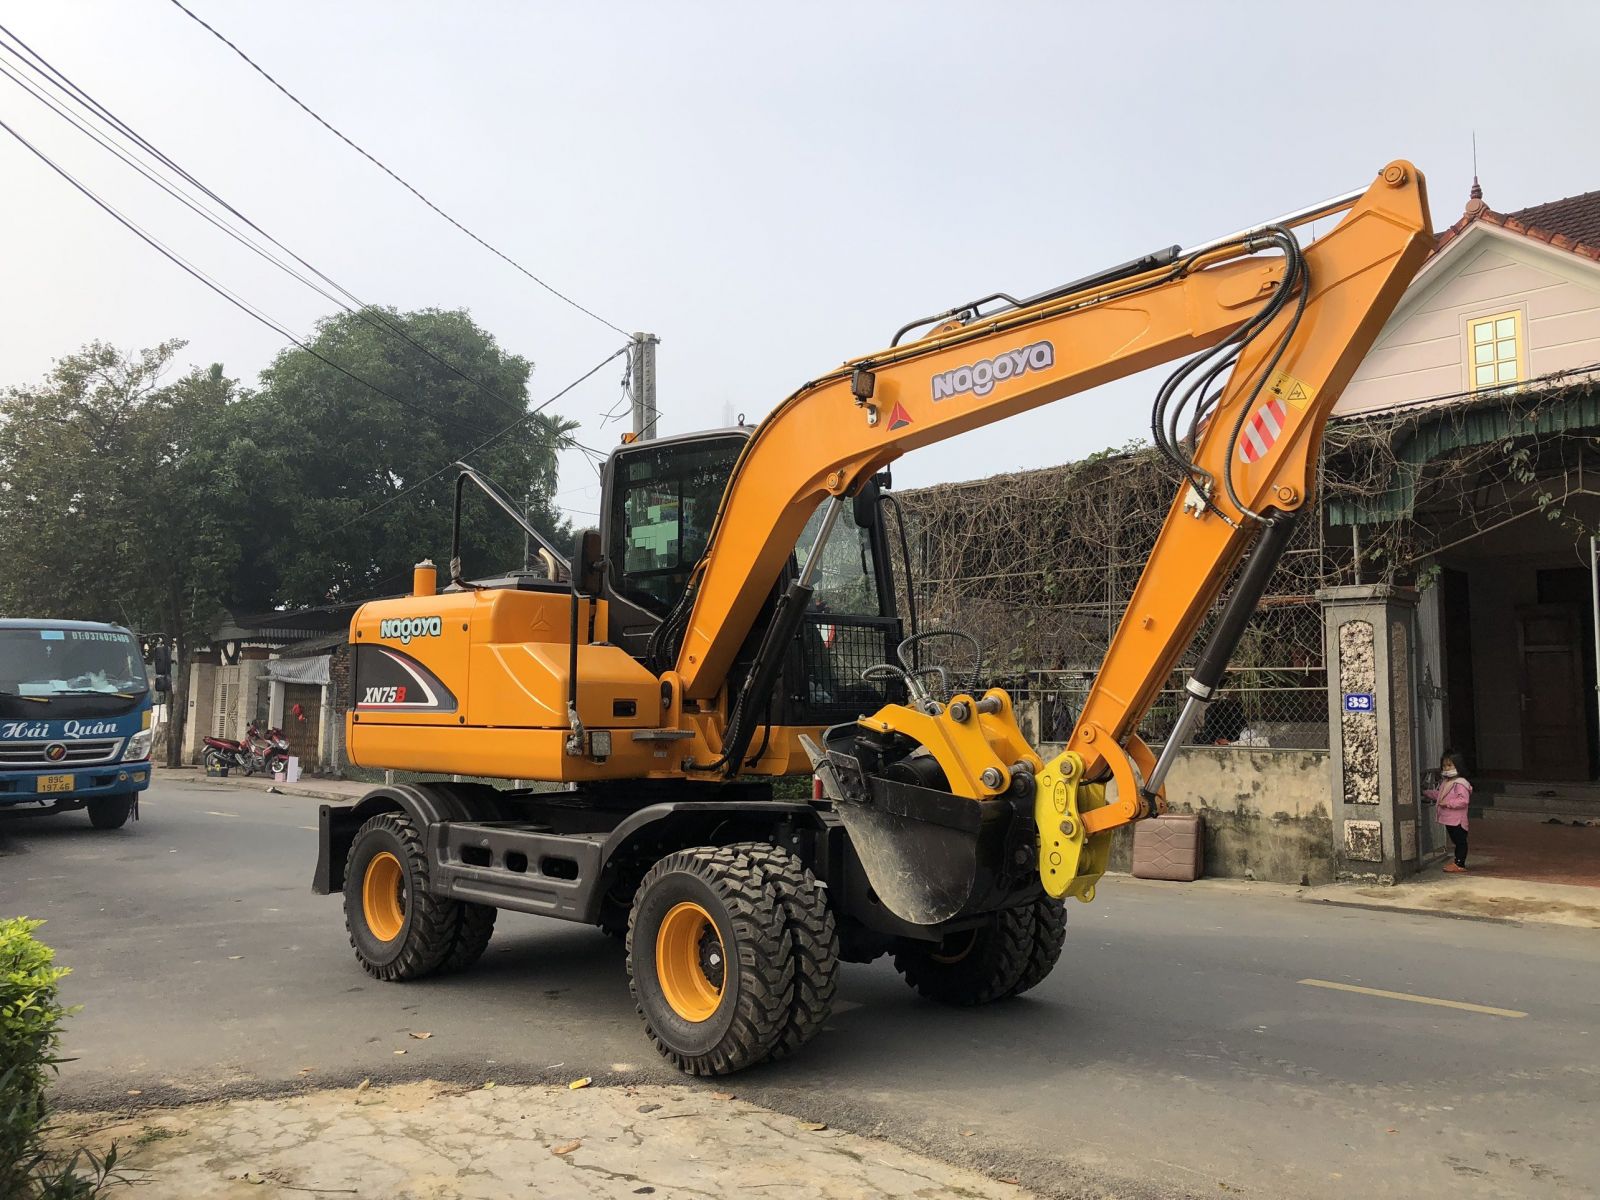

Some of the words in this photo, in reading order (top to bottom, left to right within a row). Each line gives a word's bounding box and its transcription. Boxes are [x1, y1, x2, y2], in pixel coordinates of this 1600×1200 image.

[932, 341, 1054, 401] Nagoya
[380, 616, 442, 645] Nagoya
[363, 686, 407, 703] XN75B
[1348, 696, 1369, 708] 32
[63, 720, 118, 739] Quân
[48, 776, 64, 784] 89C
